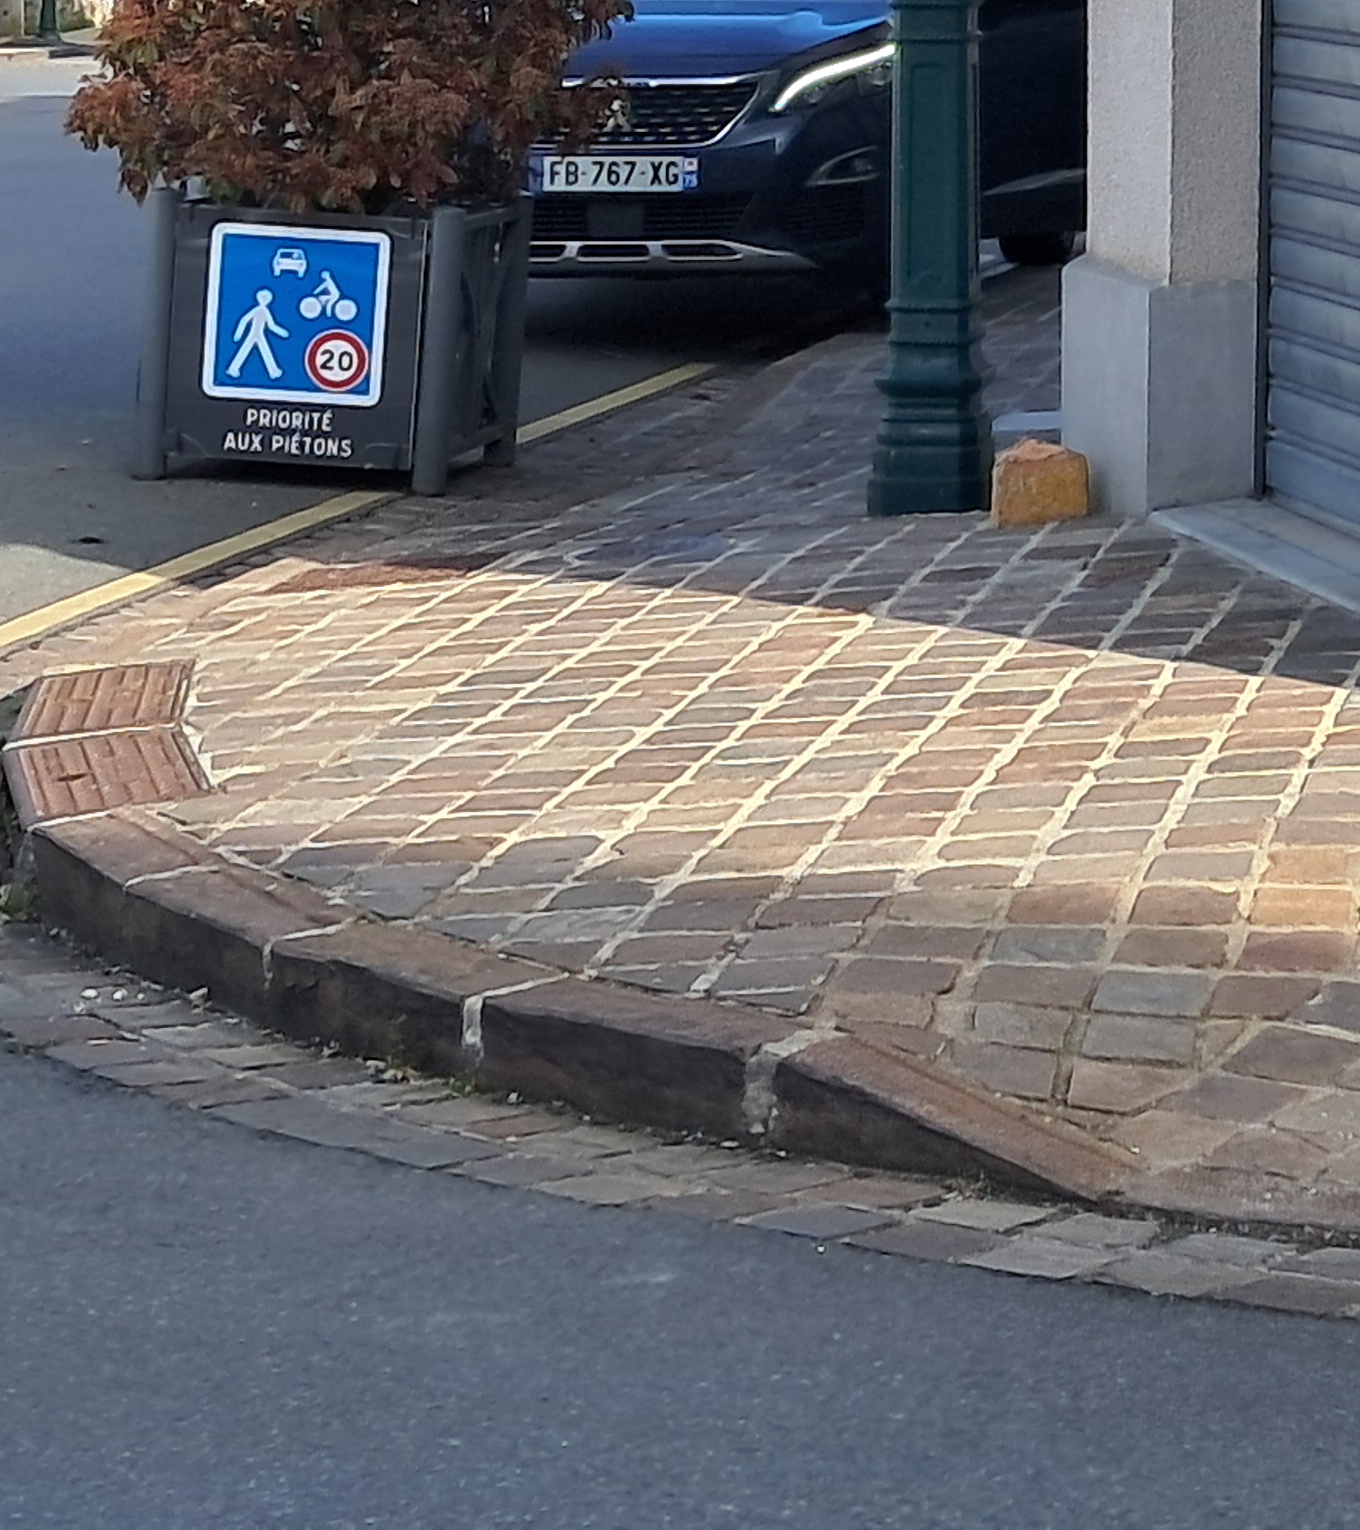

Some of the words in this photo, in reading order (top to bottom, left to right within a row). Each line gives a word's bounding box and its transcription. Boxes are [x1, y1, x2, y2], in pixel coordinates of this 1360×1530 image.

[318, 348, 354, 372] 20
[246, 408, 333, 431] PRIORITÉ
[223, 432, 263, 452] AUX
[271, 431, 352, 457] PIÉTONS
